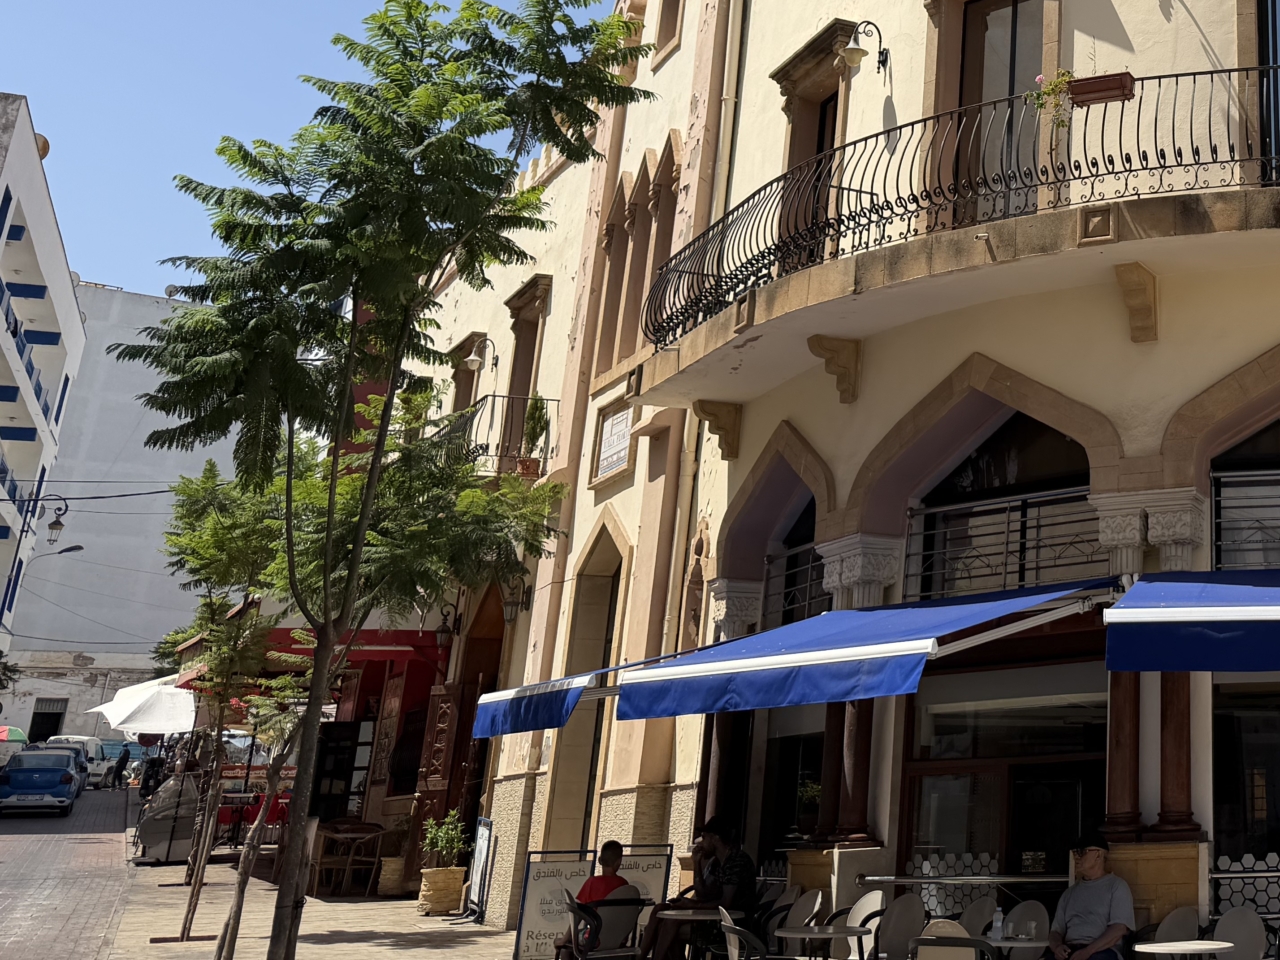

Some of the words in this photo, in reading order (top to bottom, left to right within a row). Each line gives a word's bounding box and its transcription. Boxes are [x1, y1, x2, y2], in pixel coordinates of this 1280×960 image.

[619, 860, 640, 873] بالفند
[641, 860, 662, 873] خاص
[532, 868, 563, 882] بالفندق
[565, 867, 587, 881] خاص
